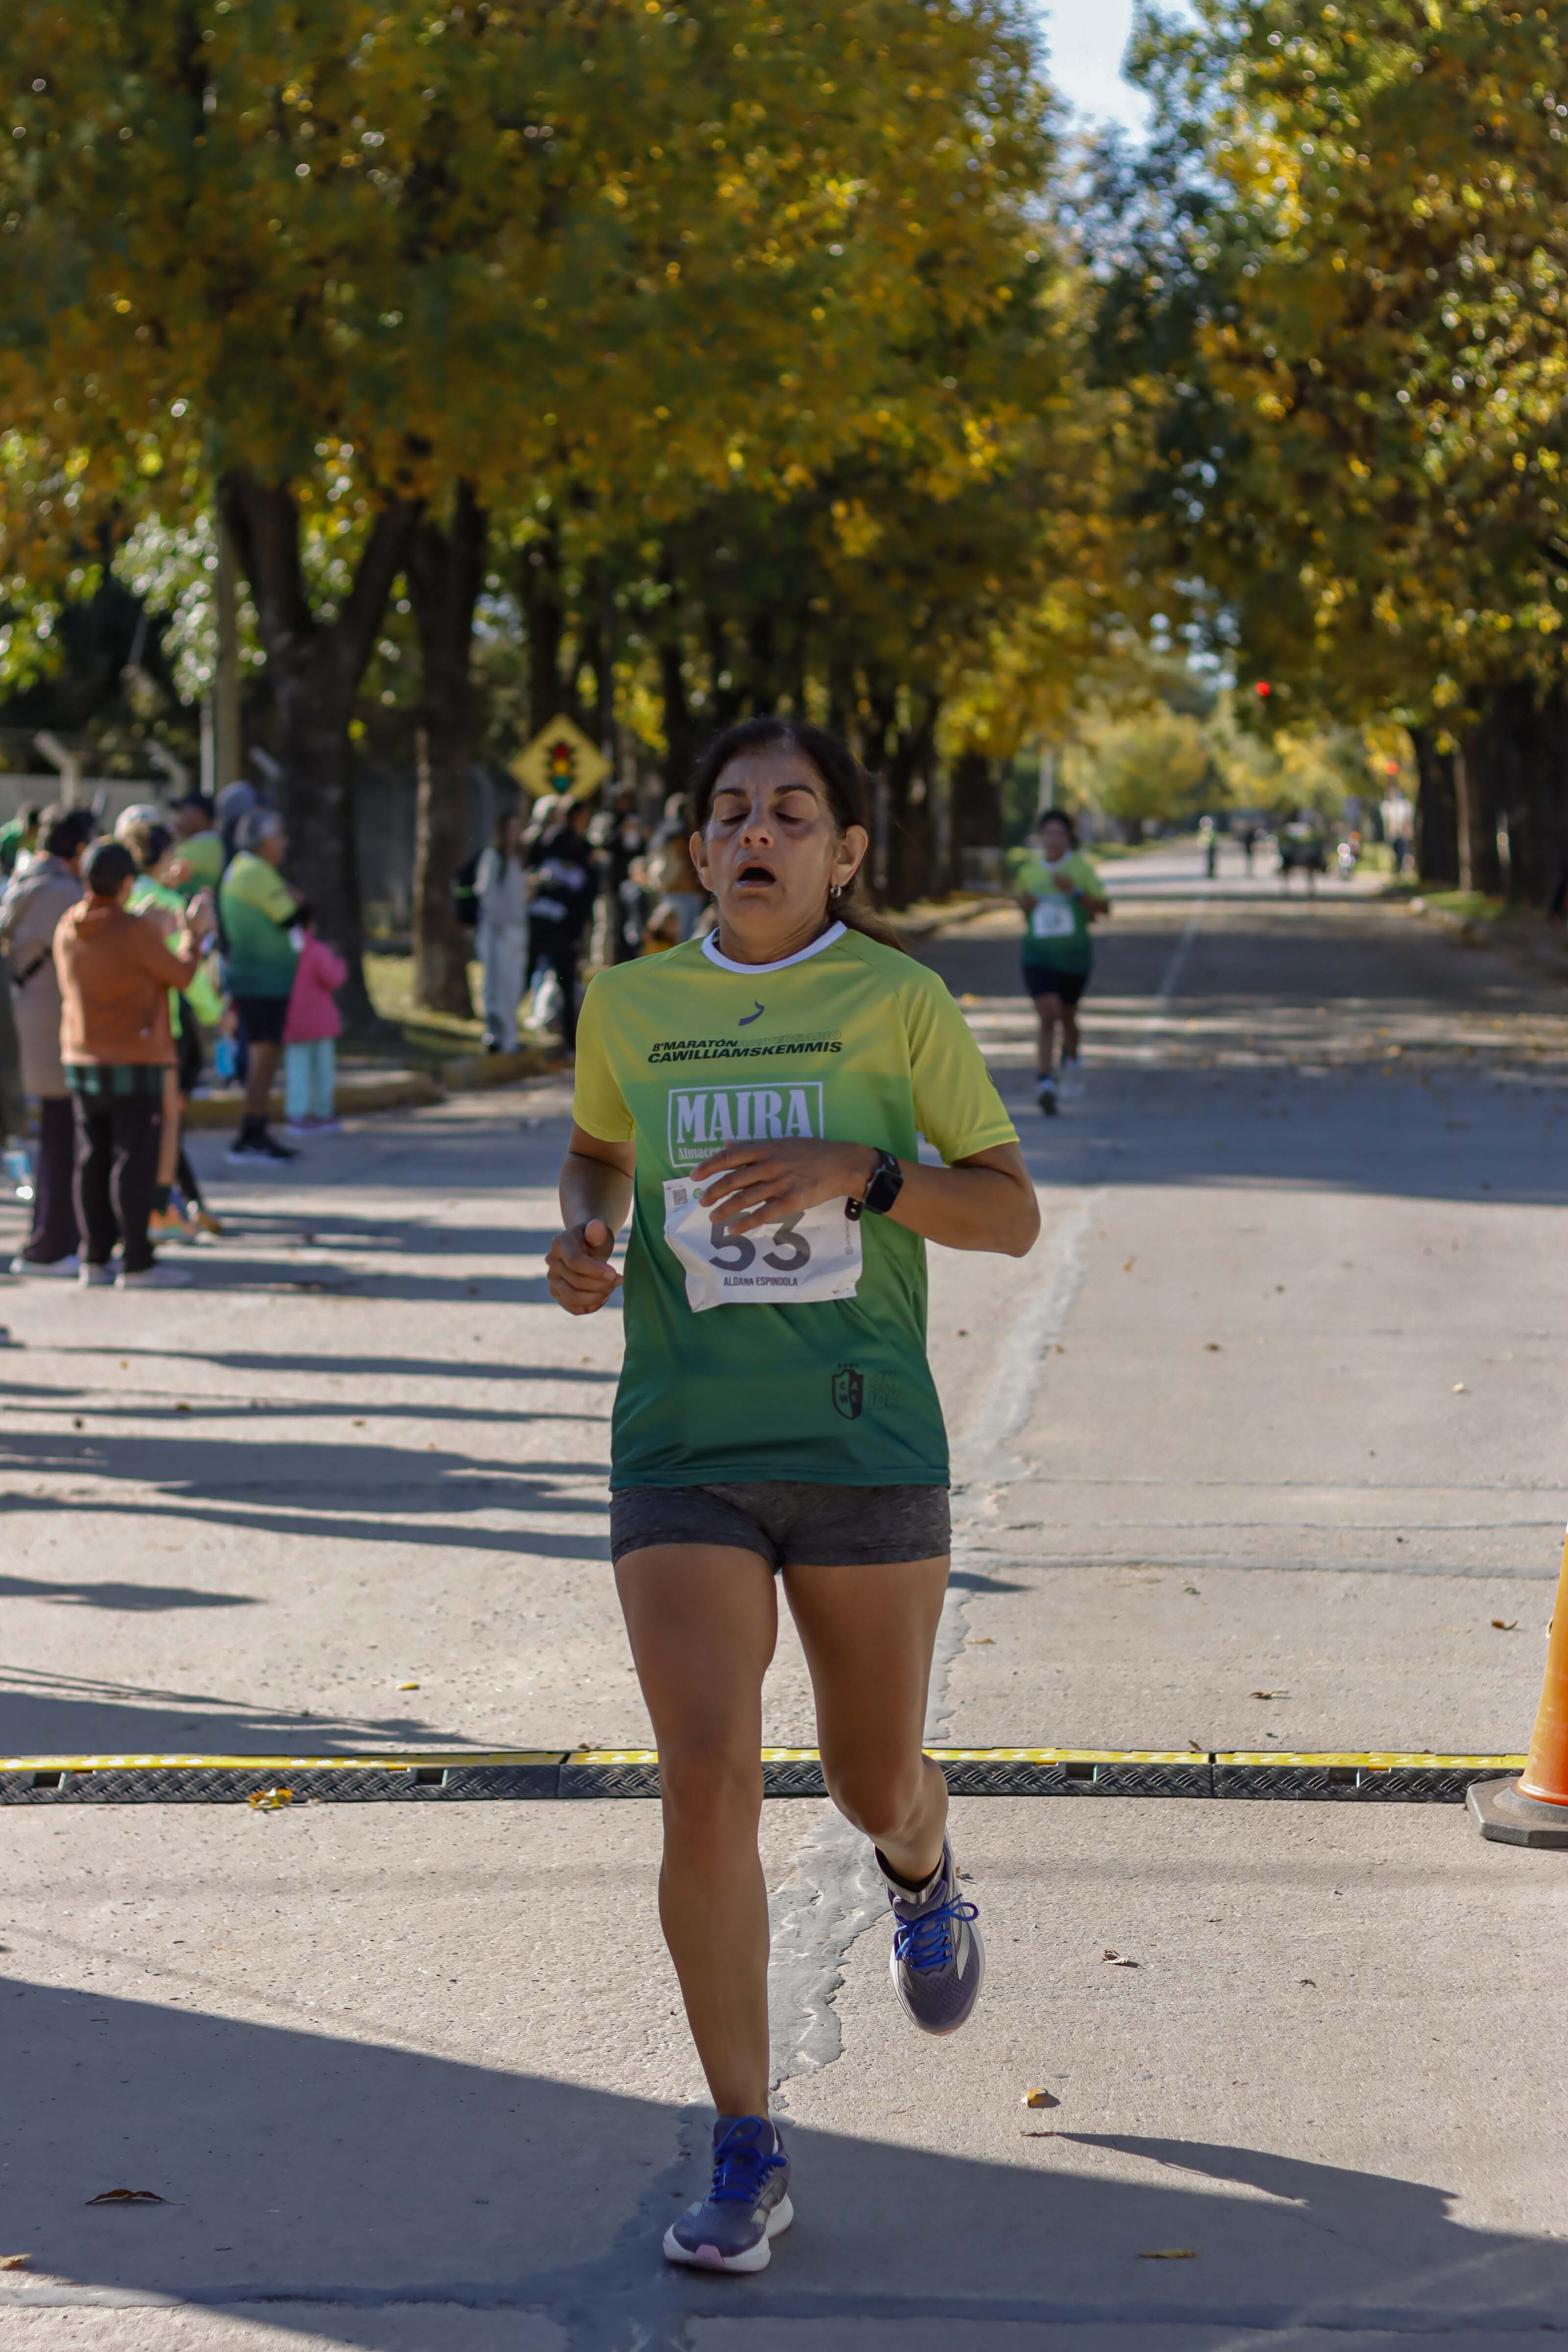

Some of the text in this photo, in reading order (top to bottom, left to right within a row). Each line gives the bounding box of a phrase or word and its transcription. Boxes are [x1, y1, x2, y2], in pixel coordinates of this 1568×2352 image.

[648, 1041, 842, 1063] CAWILLIAMSKEMMIS
[677, 1089, 813, 1143] MAIRA
[709, 1210, 811, 1272] 53
[724, 1276, 798, 1286] ALDANA ESPINDOLA
